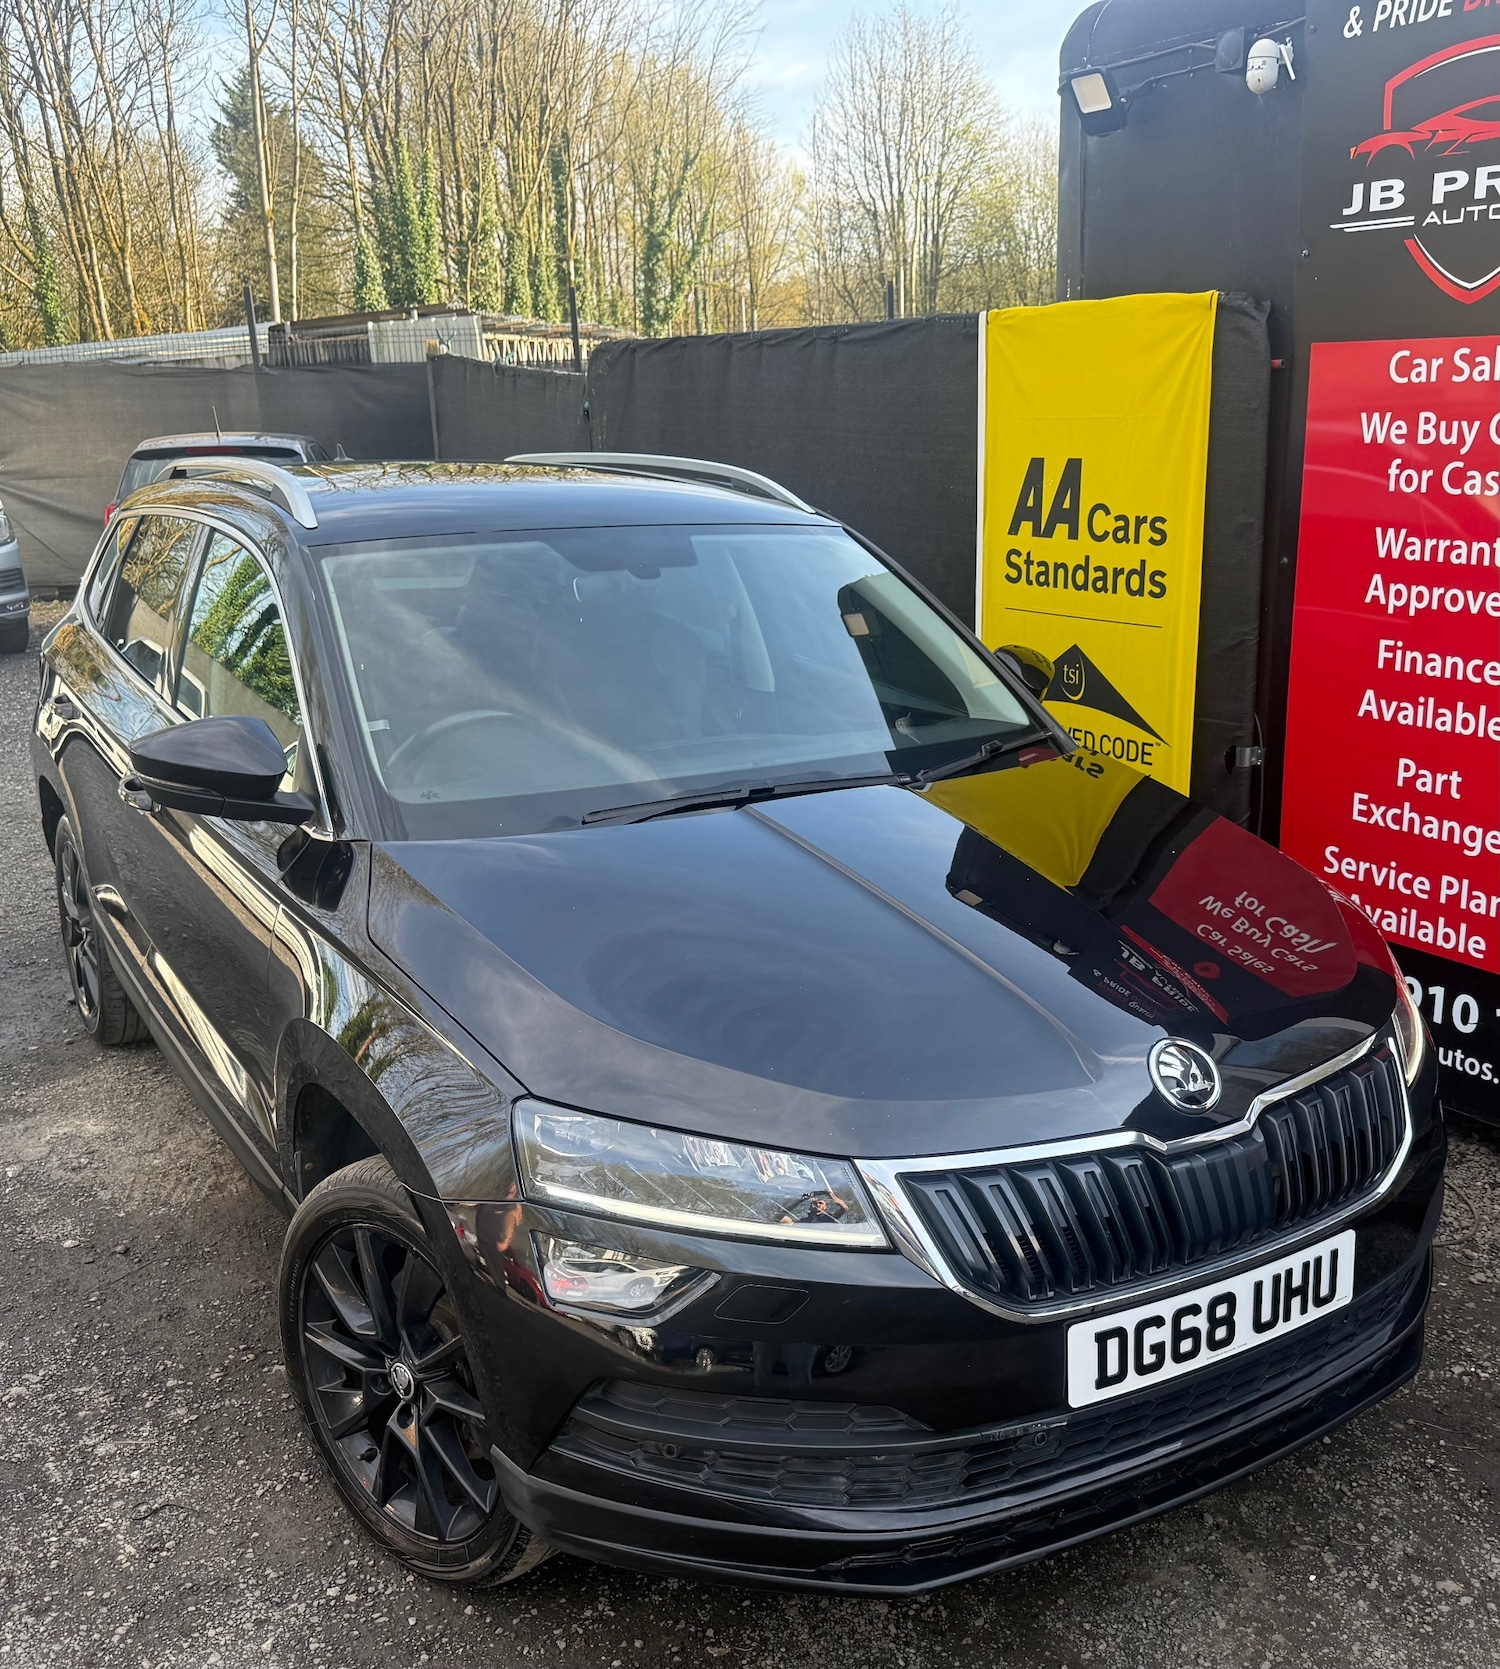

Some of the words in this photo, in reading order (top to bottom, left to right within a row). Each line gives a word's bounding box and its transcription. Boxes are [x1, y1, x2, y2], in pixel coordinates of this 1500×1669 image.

[1343, 6, 1364, 38] &
[1372, 0, 1453, 32] PRIDE
[1342, 179, 1405, 215] JB
[1389, 350, 1443, 384] Car
[1361, 411, 1408, 445] We
[1417, 411, 1481, 455] Buy
[1388, 458, 1434, 493] for
[1441, 461, 1500, 497] Cas
[1007, 457, 1082, 540] AA
[1087, 503, 1168, 547] Cars
[1004, 548, 1168, 599] Standards
[1365, 573, 1500, 617] Approve
[1063, 664, 1080, 685] tsi
[1377, 638, 1500, 686] Finance
[1357, 688, 1500, 742] Available
[1397, 757, 1462, 800] Part
[1352, 792, 1500, 857] Exchange
[1323, 845, 1430, 900] Service
[1094, 1291, 1237, 1390] DG68
[1252, 1248, 1339, 1335] UHU
